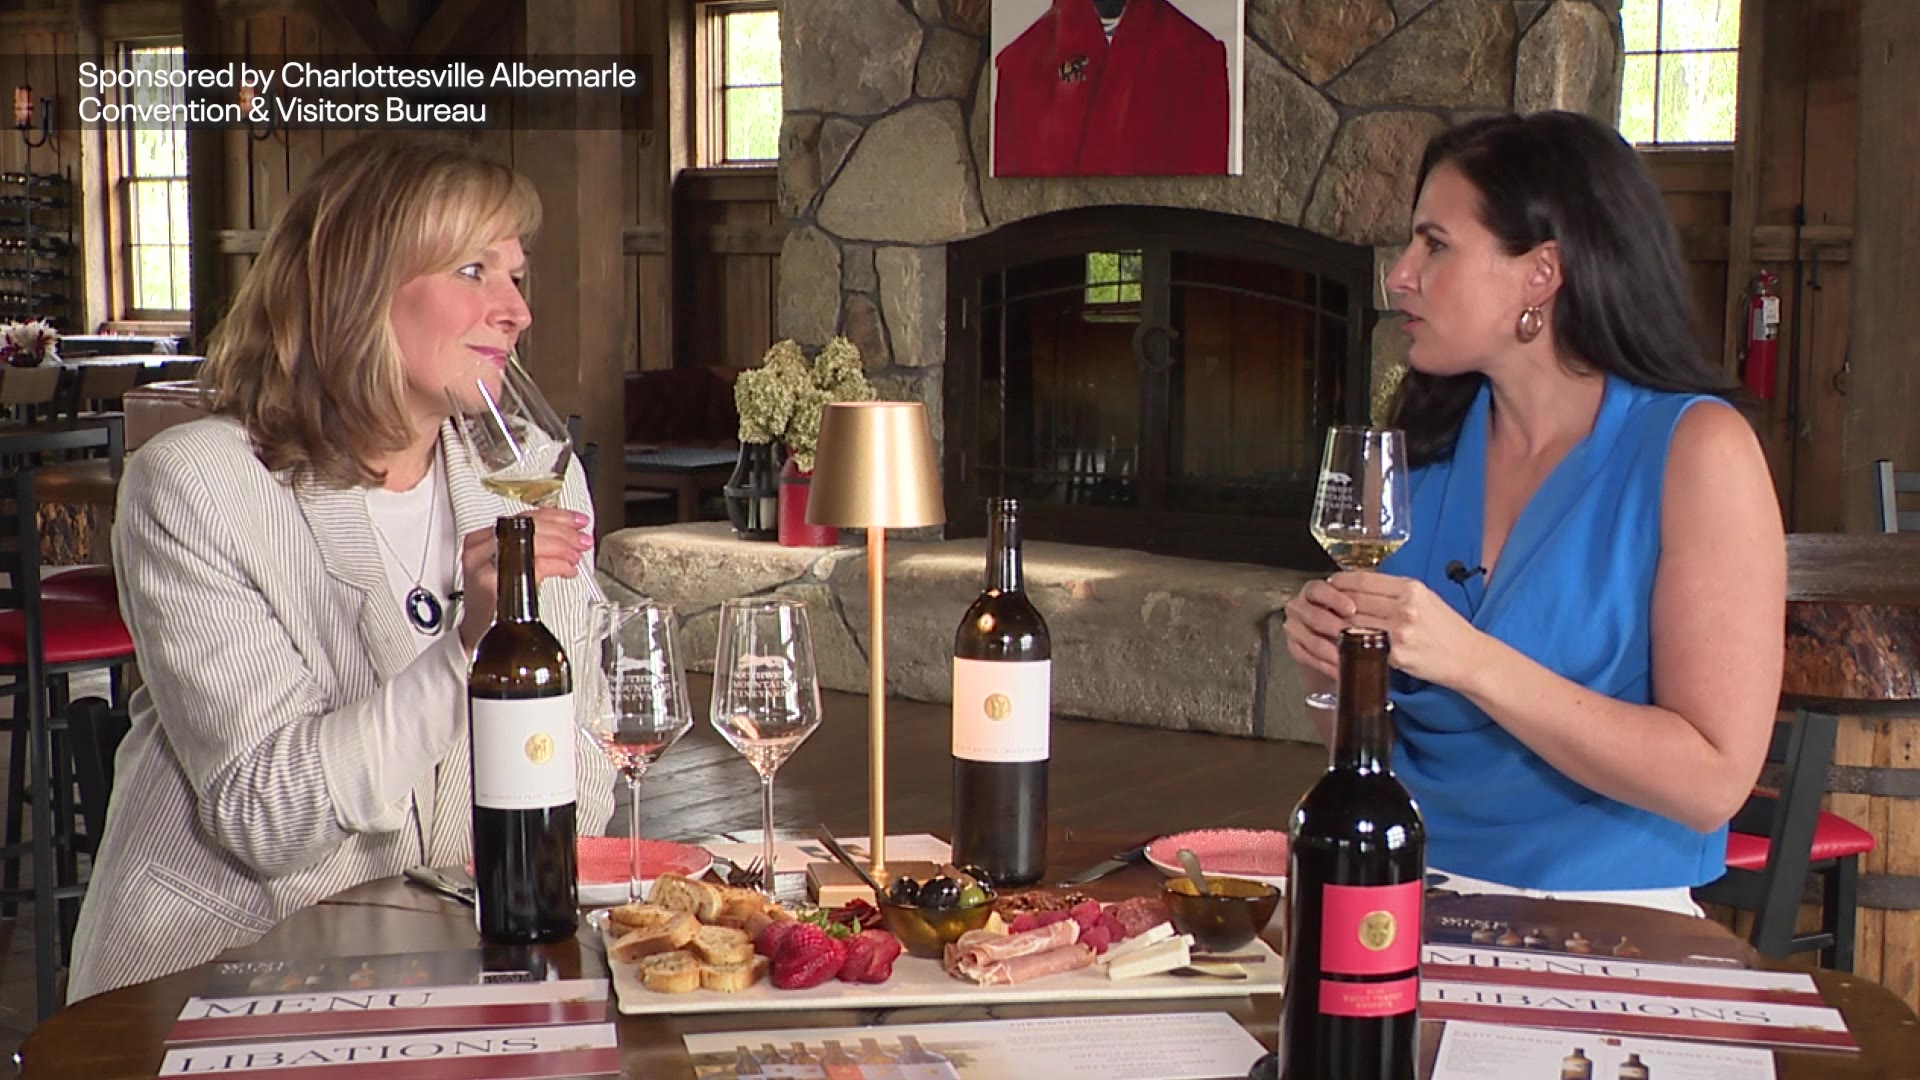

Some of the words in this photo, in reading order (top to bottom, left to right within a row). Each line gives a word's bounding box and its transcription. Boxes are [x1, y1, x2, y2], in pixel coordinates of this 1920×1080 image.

[1430, 951, 1641, 979] MENU
[203, 992, 432, 1018] MENU
[1438, 988, 1771, 1023] LIBATIONS
[180, 1036, 540, 1072] LIBATIONS
